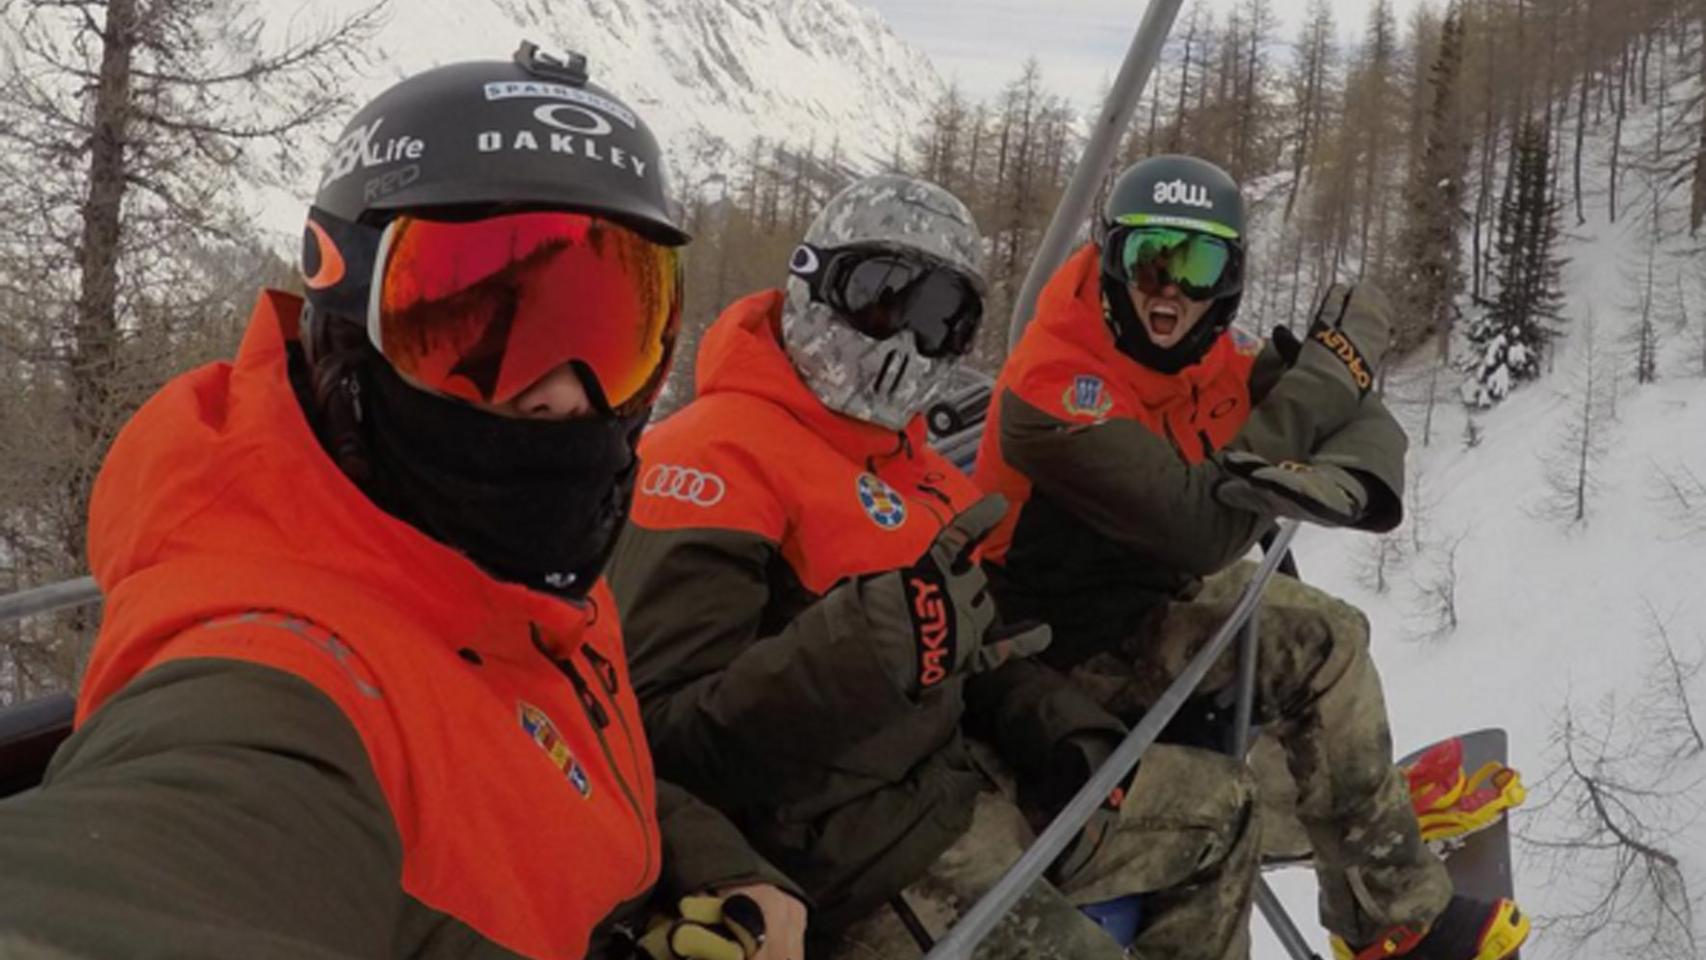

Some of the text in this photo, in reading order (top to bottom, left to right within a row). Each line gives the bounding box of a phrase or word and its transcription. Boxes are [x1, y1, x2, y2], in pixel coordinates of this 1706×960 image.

[478, 130, 646, 178] OAKLEY
[1316, 330, 1371, 389] OAKLEY
[910, 578, 949, 686] OAKLEY
